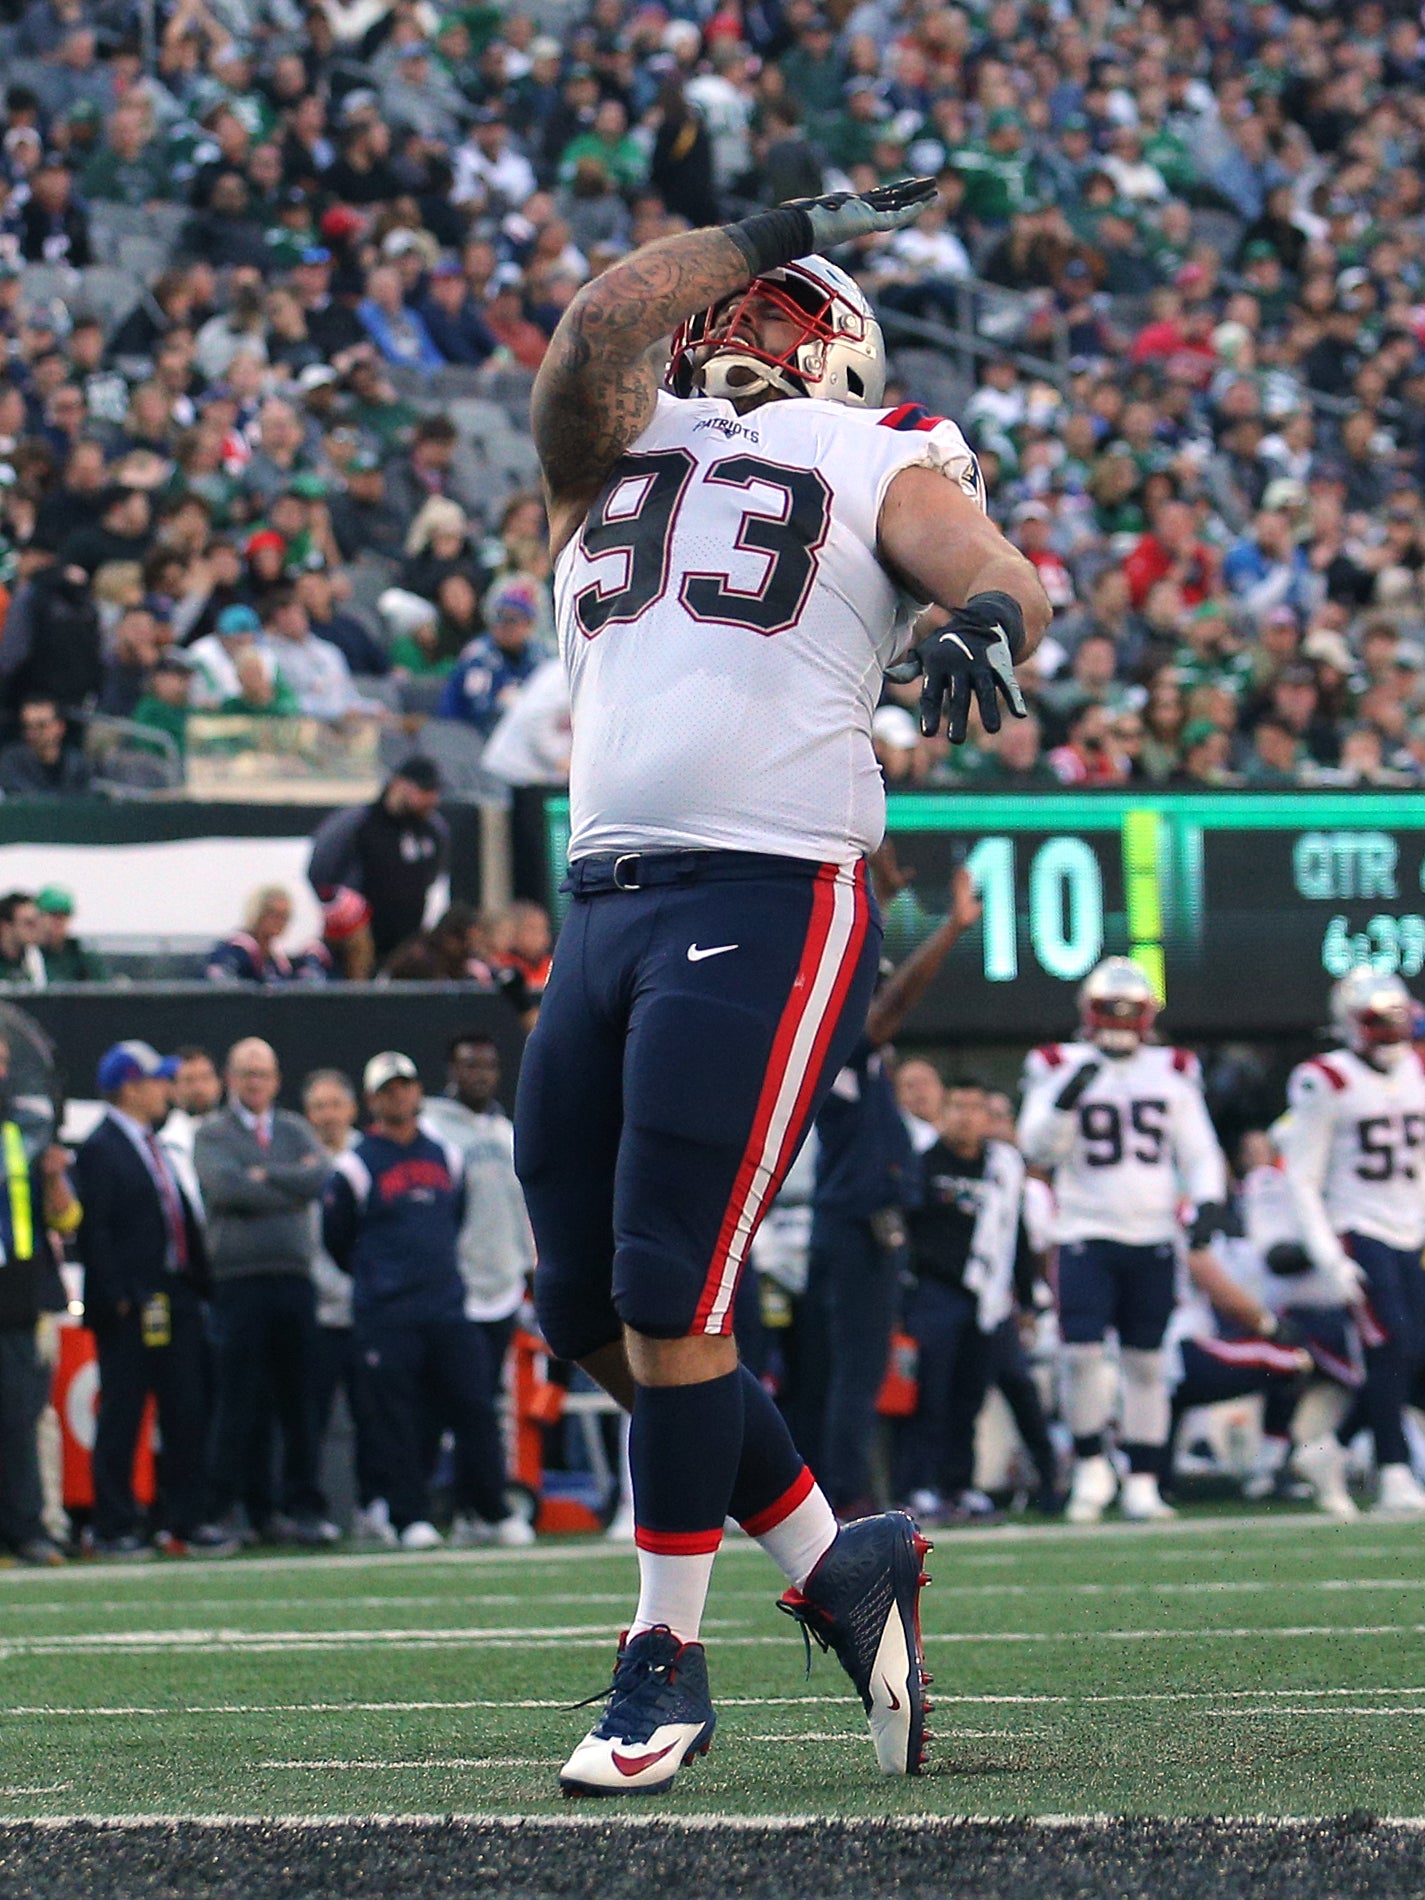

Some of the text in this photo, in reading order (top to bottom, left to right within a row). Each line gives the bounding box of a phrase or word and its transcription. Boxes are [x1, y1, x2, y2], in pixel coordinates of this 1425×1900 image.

[692, 417, 760, 444] PATRIOTS
[573, 446, 835, 640] 93
[1293, 832, 1400, 900] QTR
[964, 835, 1104, 983] 10
[1080, 1099, 1168, 1168] 95
